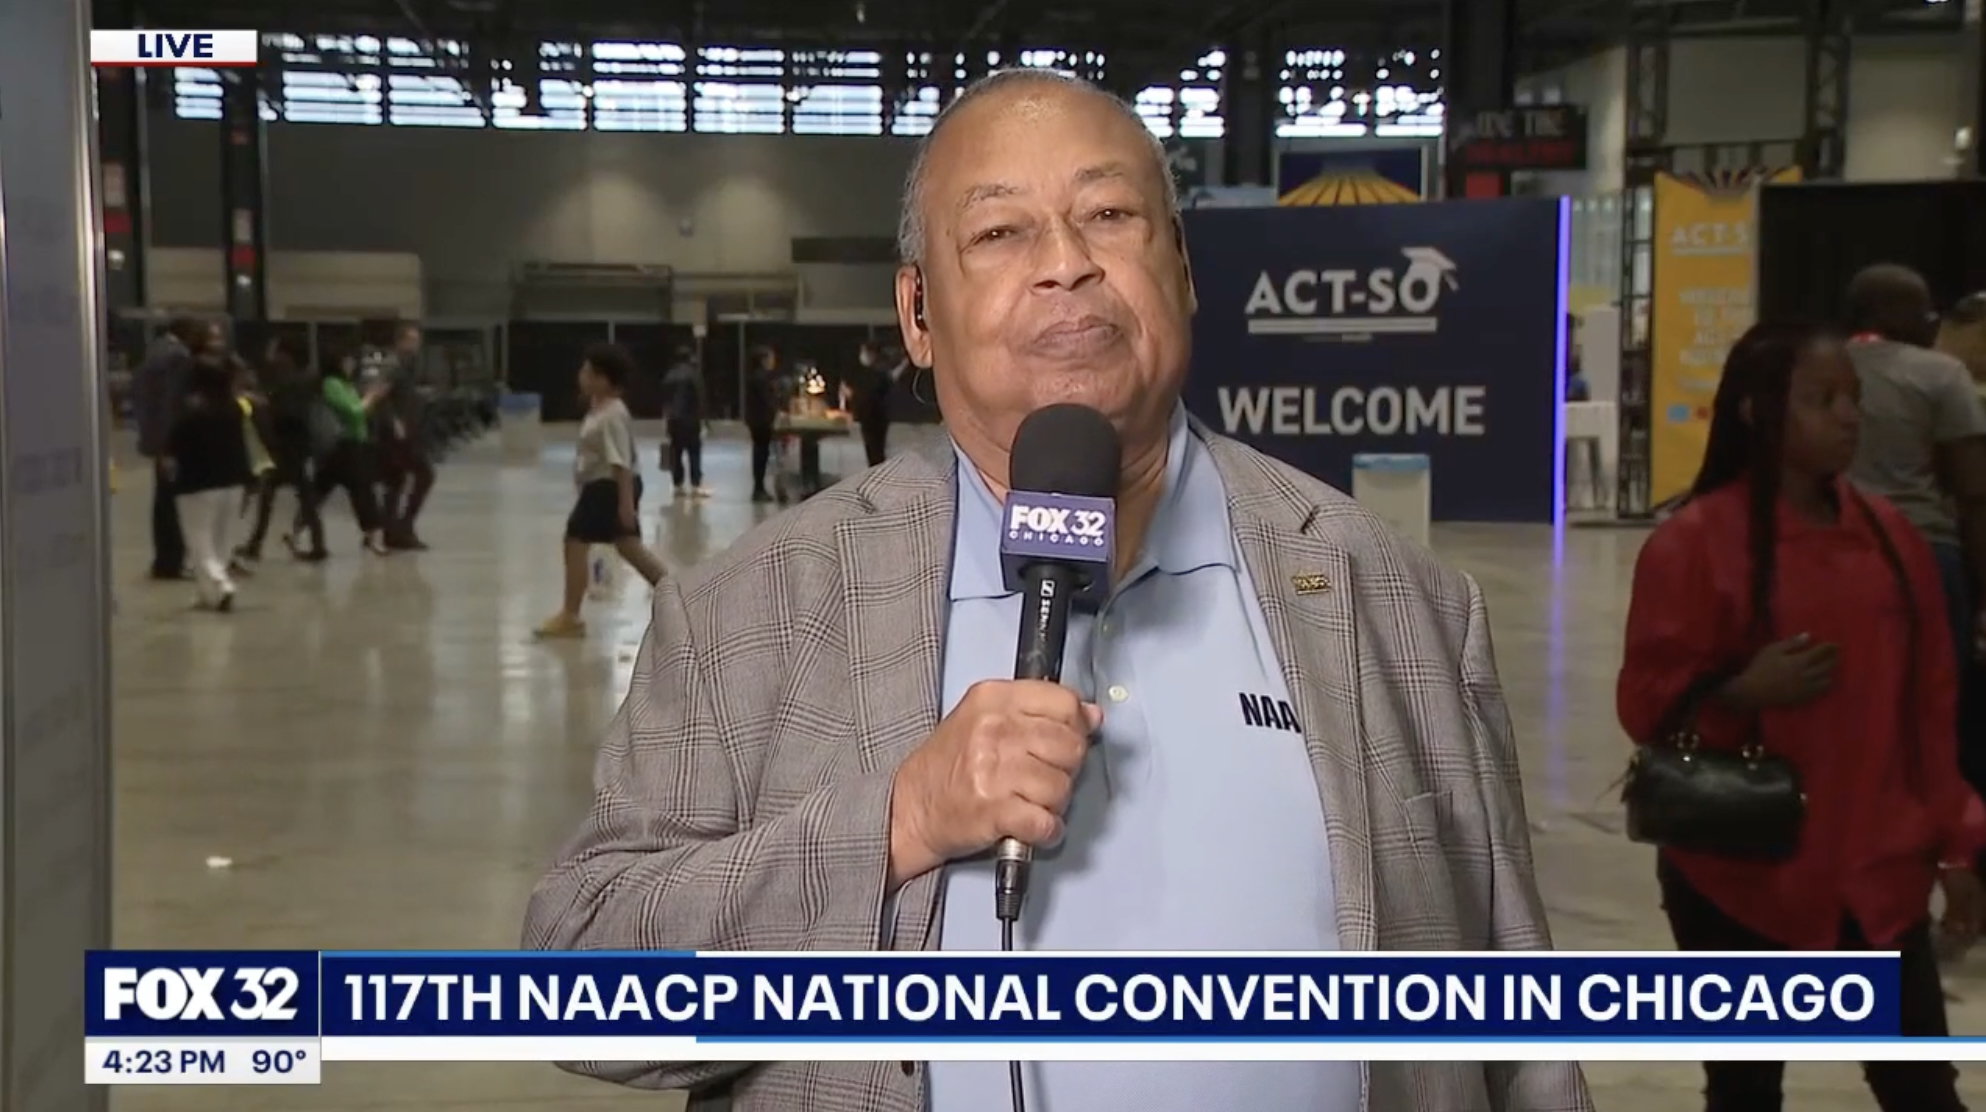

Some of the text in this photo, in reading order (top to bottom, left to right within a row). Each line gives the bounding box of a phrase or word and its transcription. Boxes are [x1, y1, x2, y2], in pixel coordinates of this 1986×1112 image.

[1244, 262, 1442, 314] ACT-SO
[1217, 386, 1486, 435] WELCOME
[1009, 531, 1105, 547] CHICAGO
[1010, 505, 1106, 537] FOX 32
[1239, 692, 1302, 734] NAA
